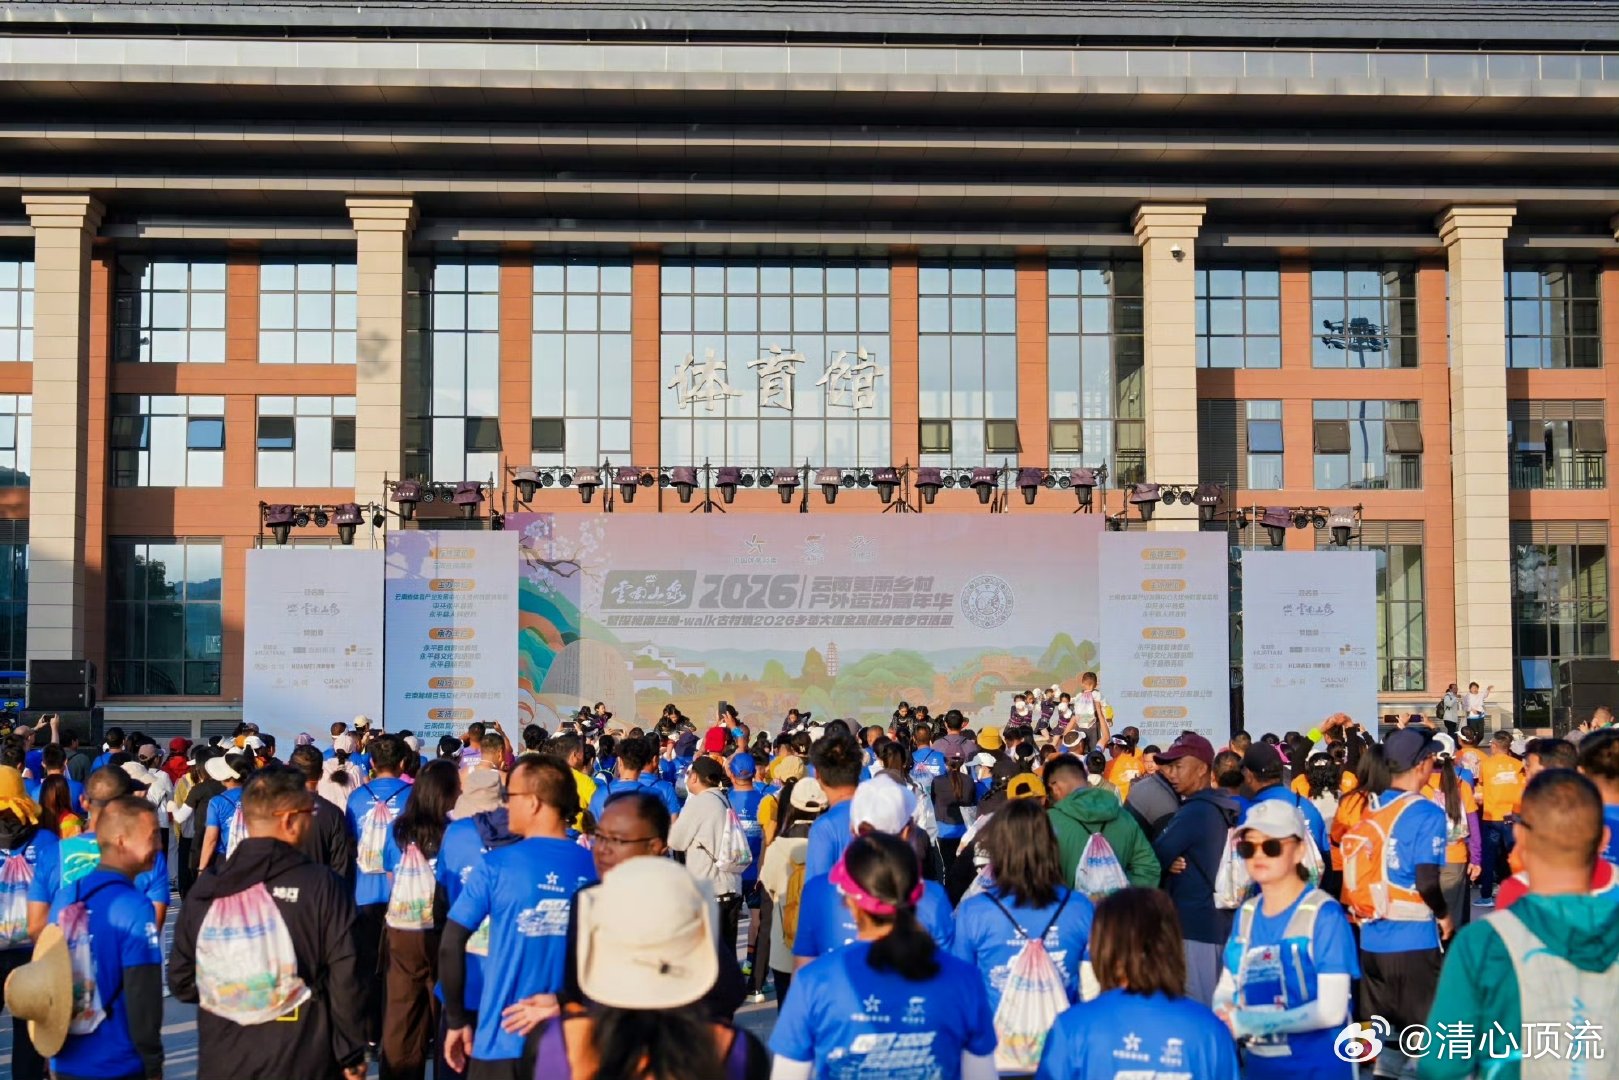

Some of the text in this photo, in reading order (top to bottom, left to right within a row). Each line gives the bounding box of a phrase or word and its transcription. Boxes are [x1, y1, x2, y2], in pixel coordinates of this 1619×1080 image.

[668, 346, 884, 411] 体育馆
[699, 574, 800, 609] 2026
[812, 576, 935, 592] 云南美丽乡村
[809, 593, 954, 611] 户外运动嘉年华
